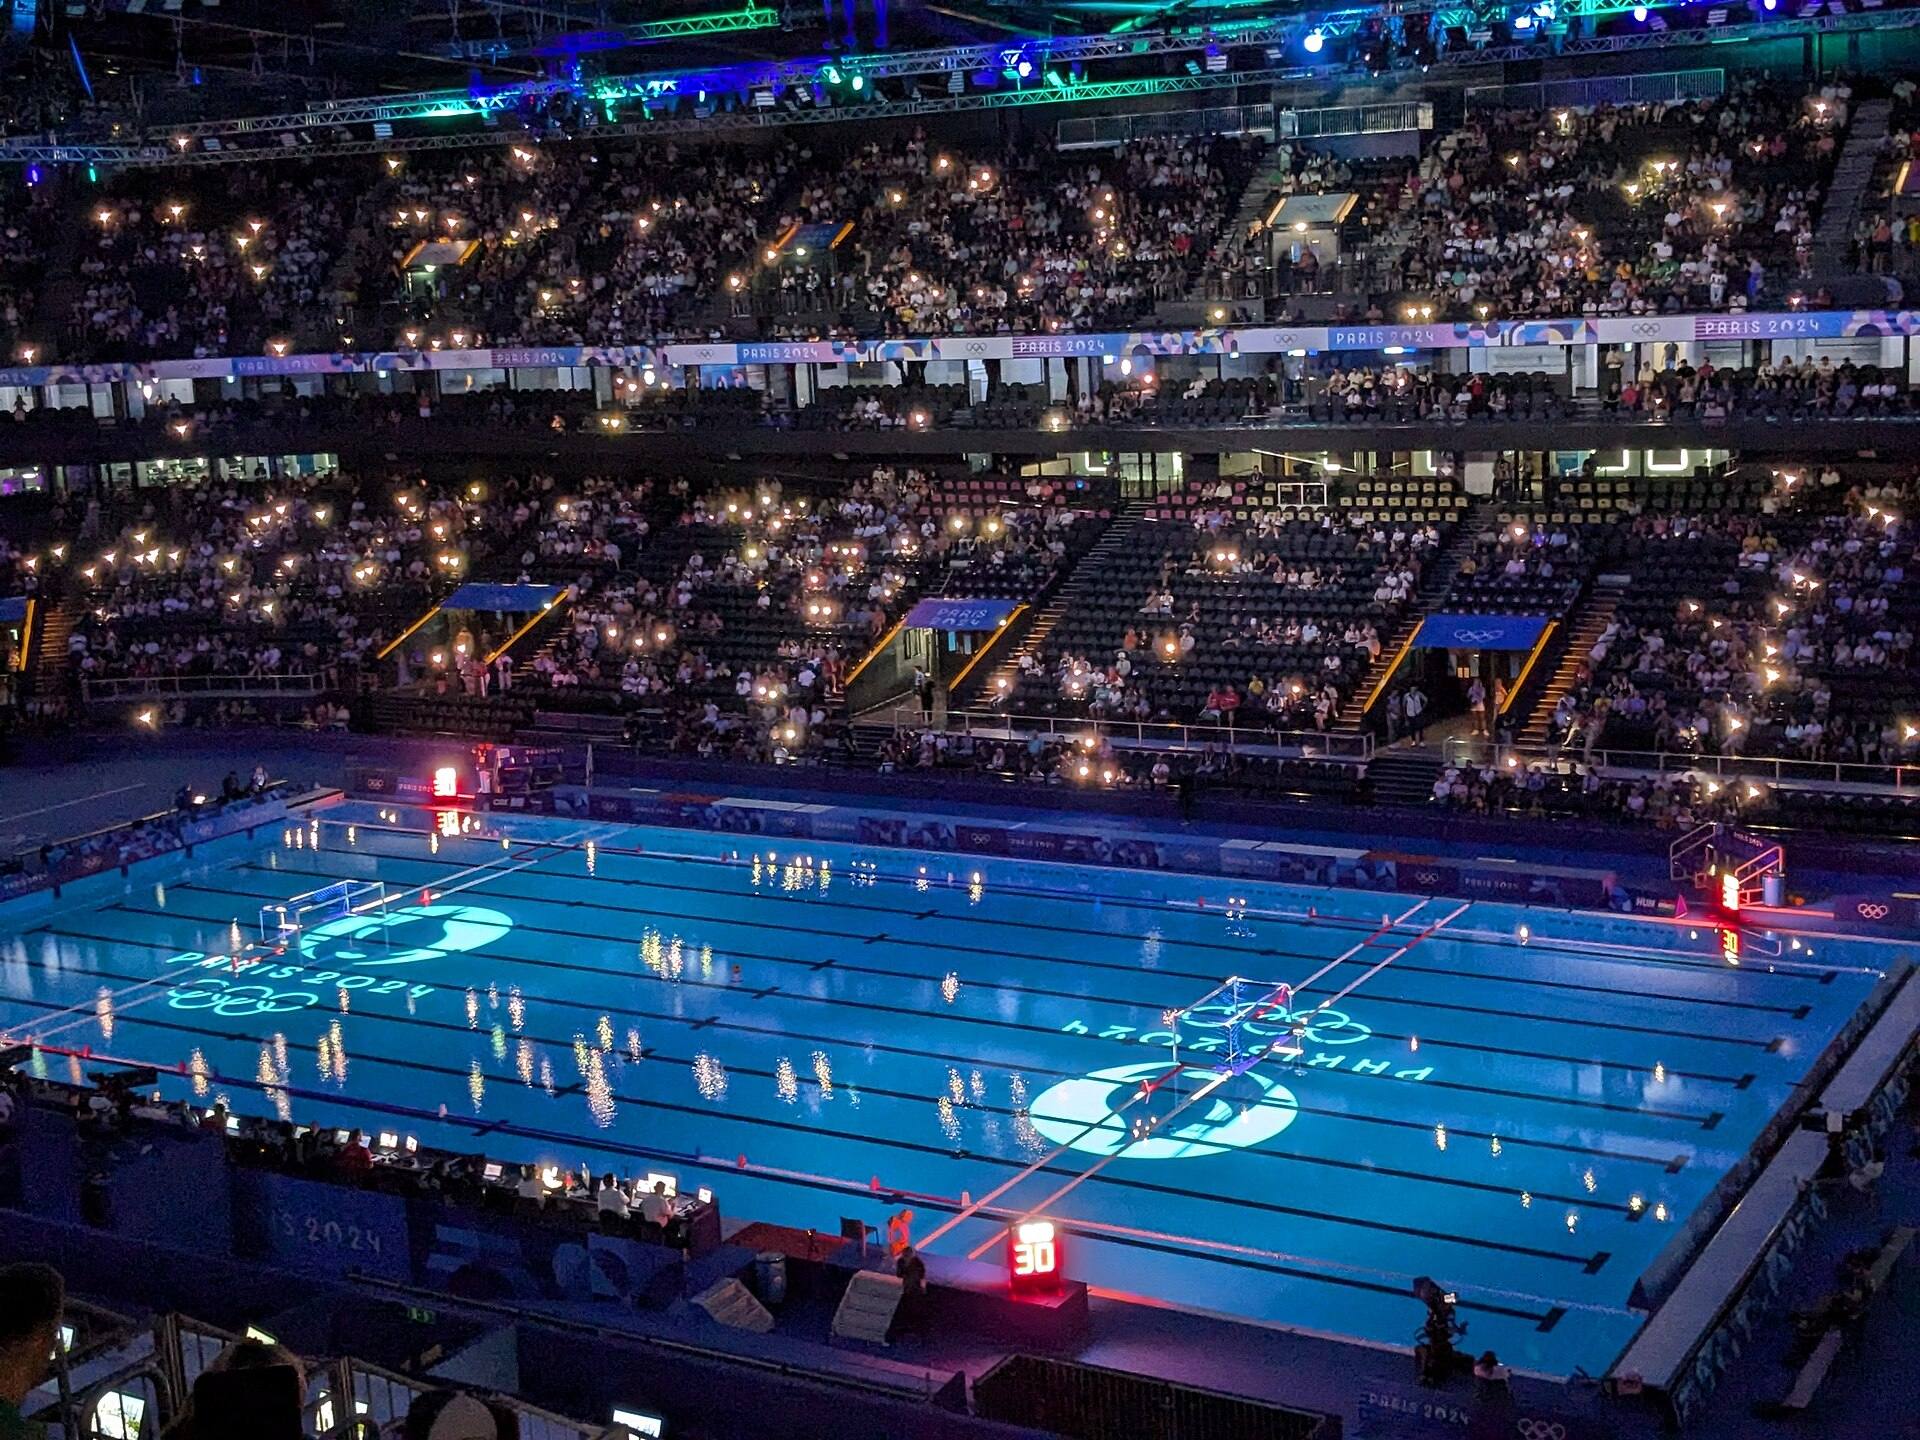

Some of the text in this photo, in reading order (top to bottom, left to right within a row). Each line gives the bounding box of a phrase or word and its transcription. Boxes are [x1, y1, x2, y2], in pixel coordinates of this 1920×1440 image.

[1704, 319, 1819, 335] PARIS 2024
[1336, 330, 1434, 345] PARIS 2024
[743, 347, 818, 358] PARIS 2024
[1020, 339, 1105, 353] PARIS 2024
[497, 352, 565, 363] PARIS 2024
[936, 608, 988, 619] PARIS
[302, 971, 435, 999] 2024
[304, 1218, 380, 1254] 2024
[1013, 1241, 1056, 1276] 30
